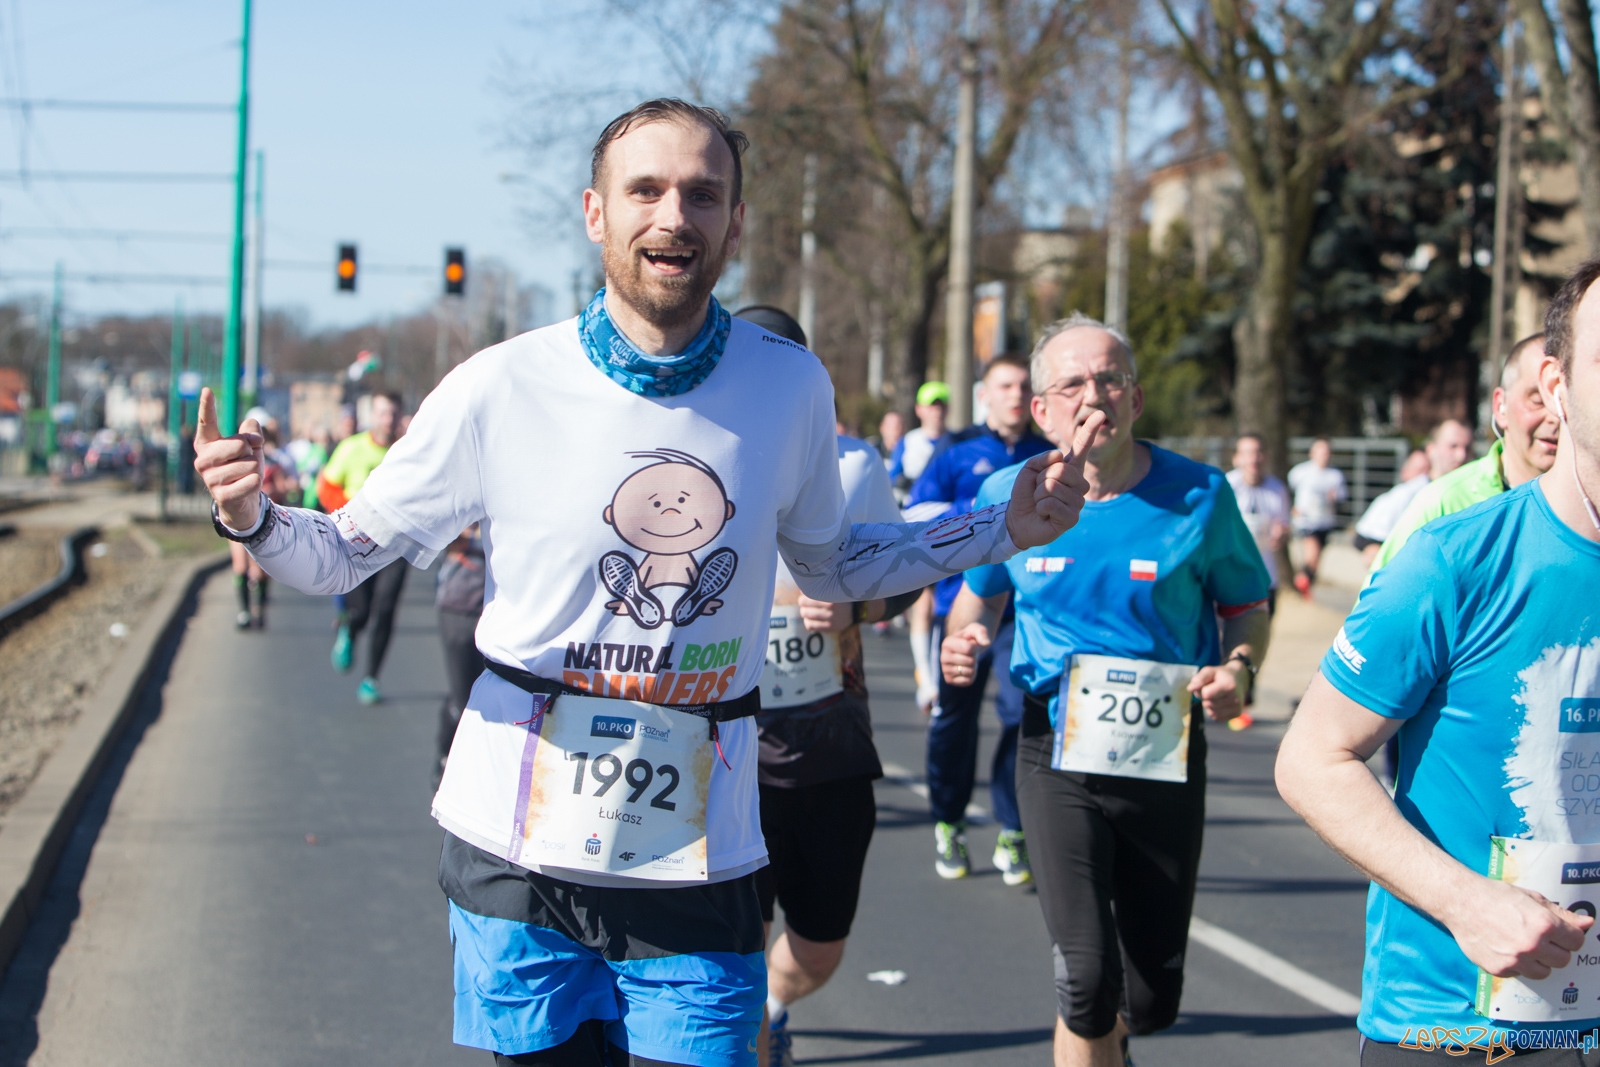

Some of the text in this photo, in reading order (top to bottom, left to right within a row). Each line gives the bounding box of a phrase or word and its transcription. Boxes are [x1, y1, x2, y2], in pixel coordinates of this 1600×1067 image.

[564, 636, 743, 674] NATURAL BORN
[1097, 693, 1163, 728] 206
[1565, 707, 1586, 722] 16.
[596, 721, 632, 733] 10. PKO
[570, 752, 680, 811] 1992
[599, 807, 643, 825] Łukasz
[618, 851, 636, 861] 4F
[1567, 868, 1580, 878] 10.
